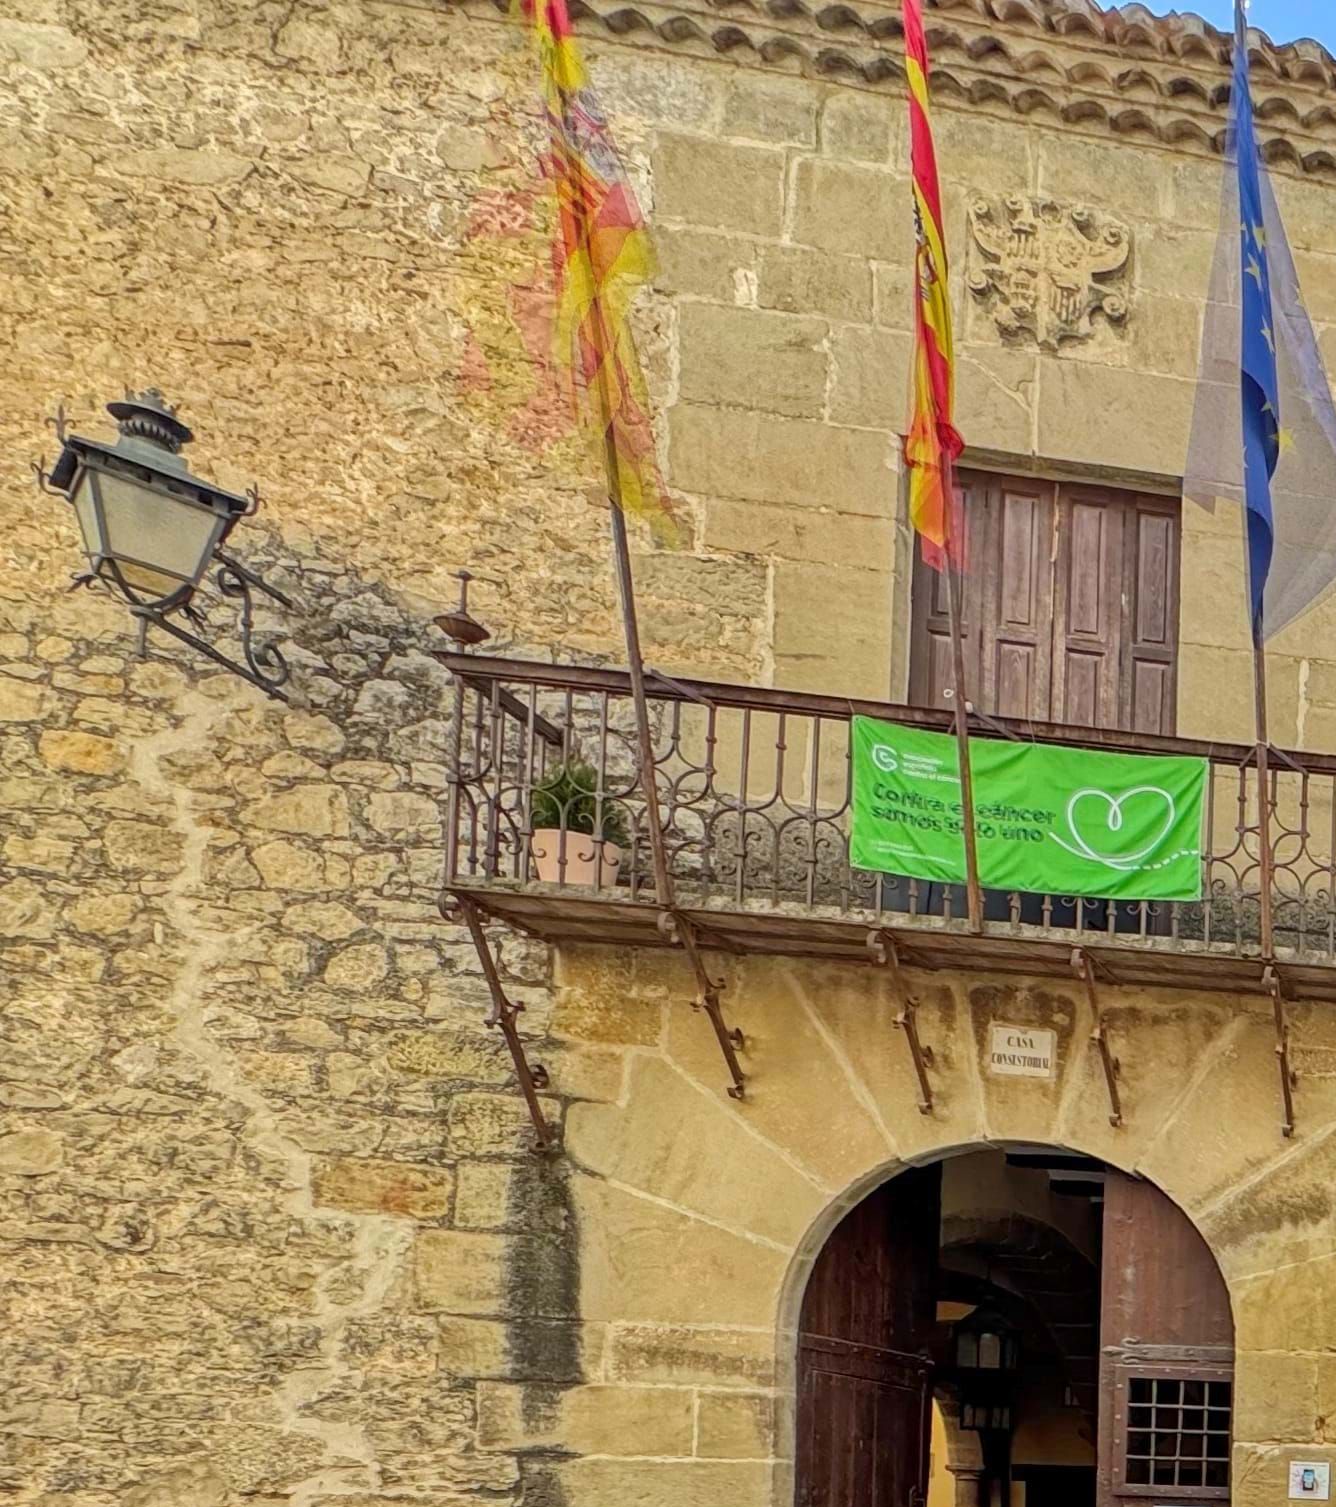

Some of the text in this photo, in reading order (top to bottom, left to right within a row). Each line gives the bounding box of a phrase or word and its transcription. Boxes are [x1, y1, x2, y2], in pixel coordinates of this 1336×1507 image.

[872, 782, 945, 813] Contra
[870, 805, 942, 834] somos
[1007, 1036, 1035, 1049] CASA
